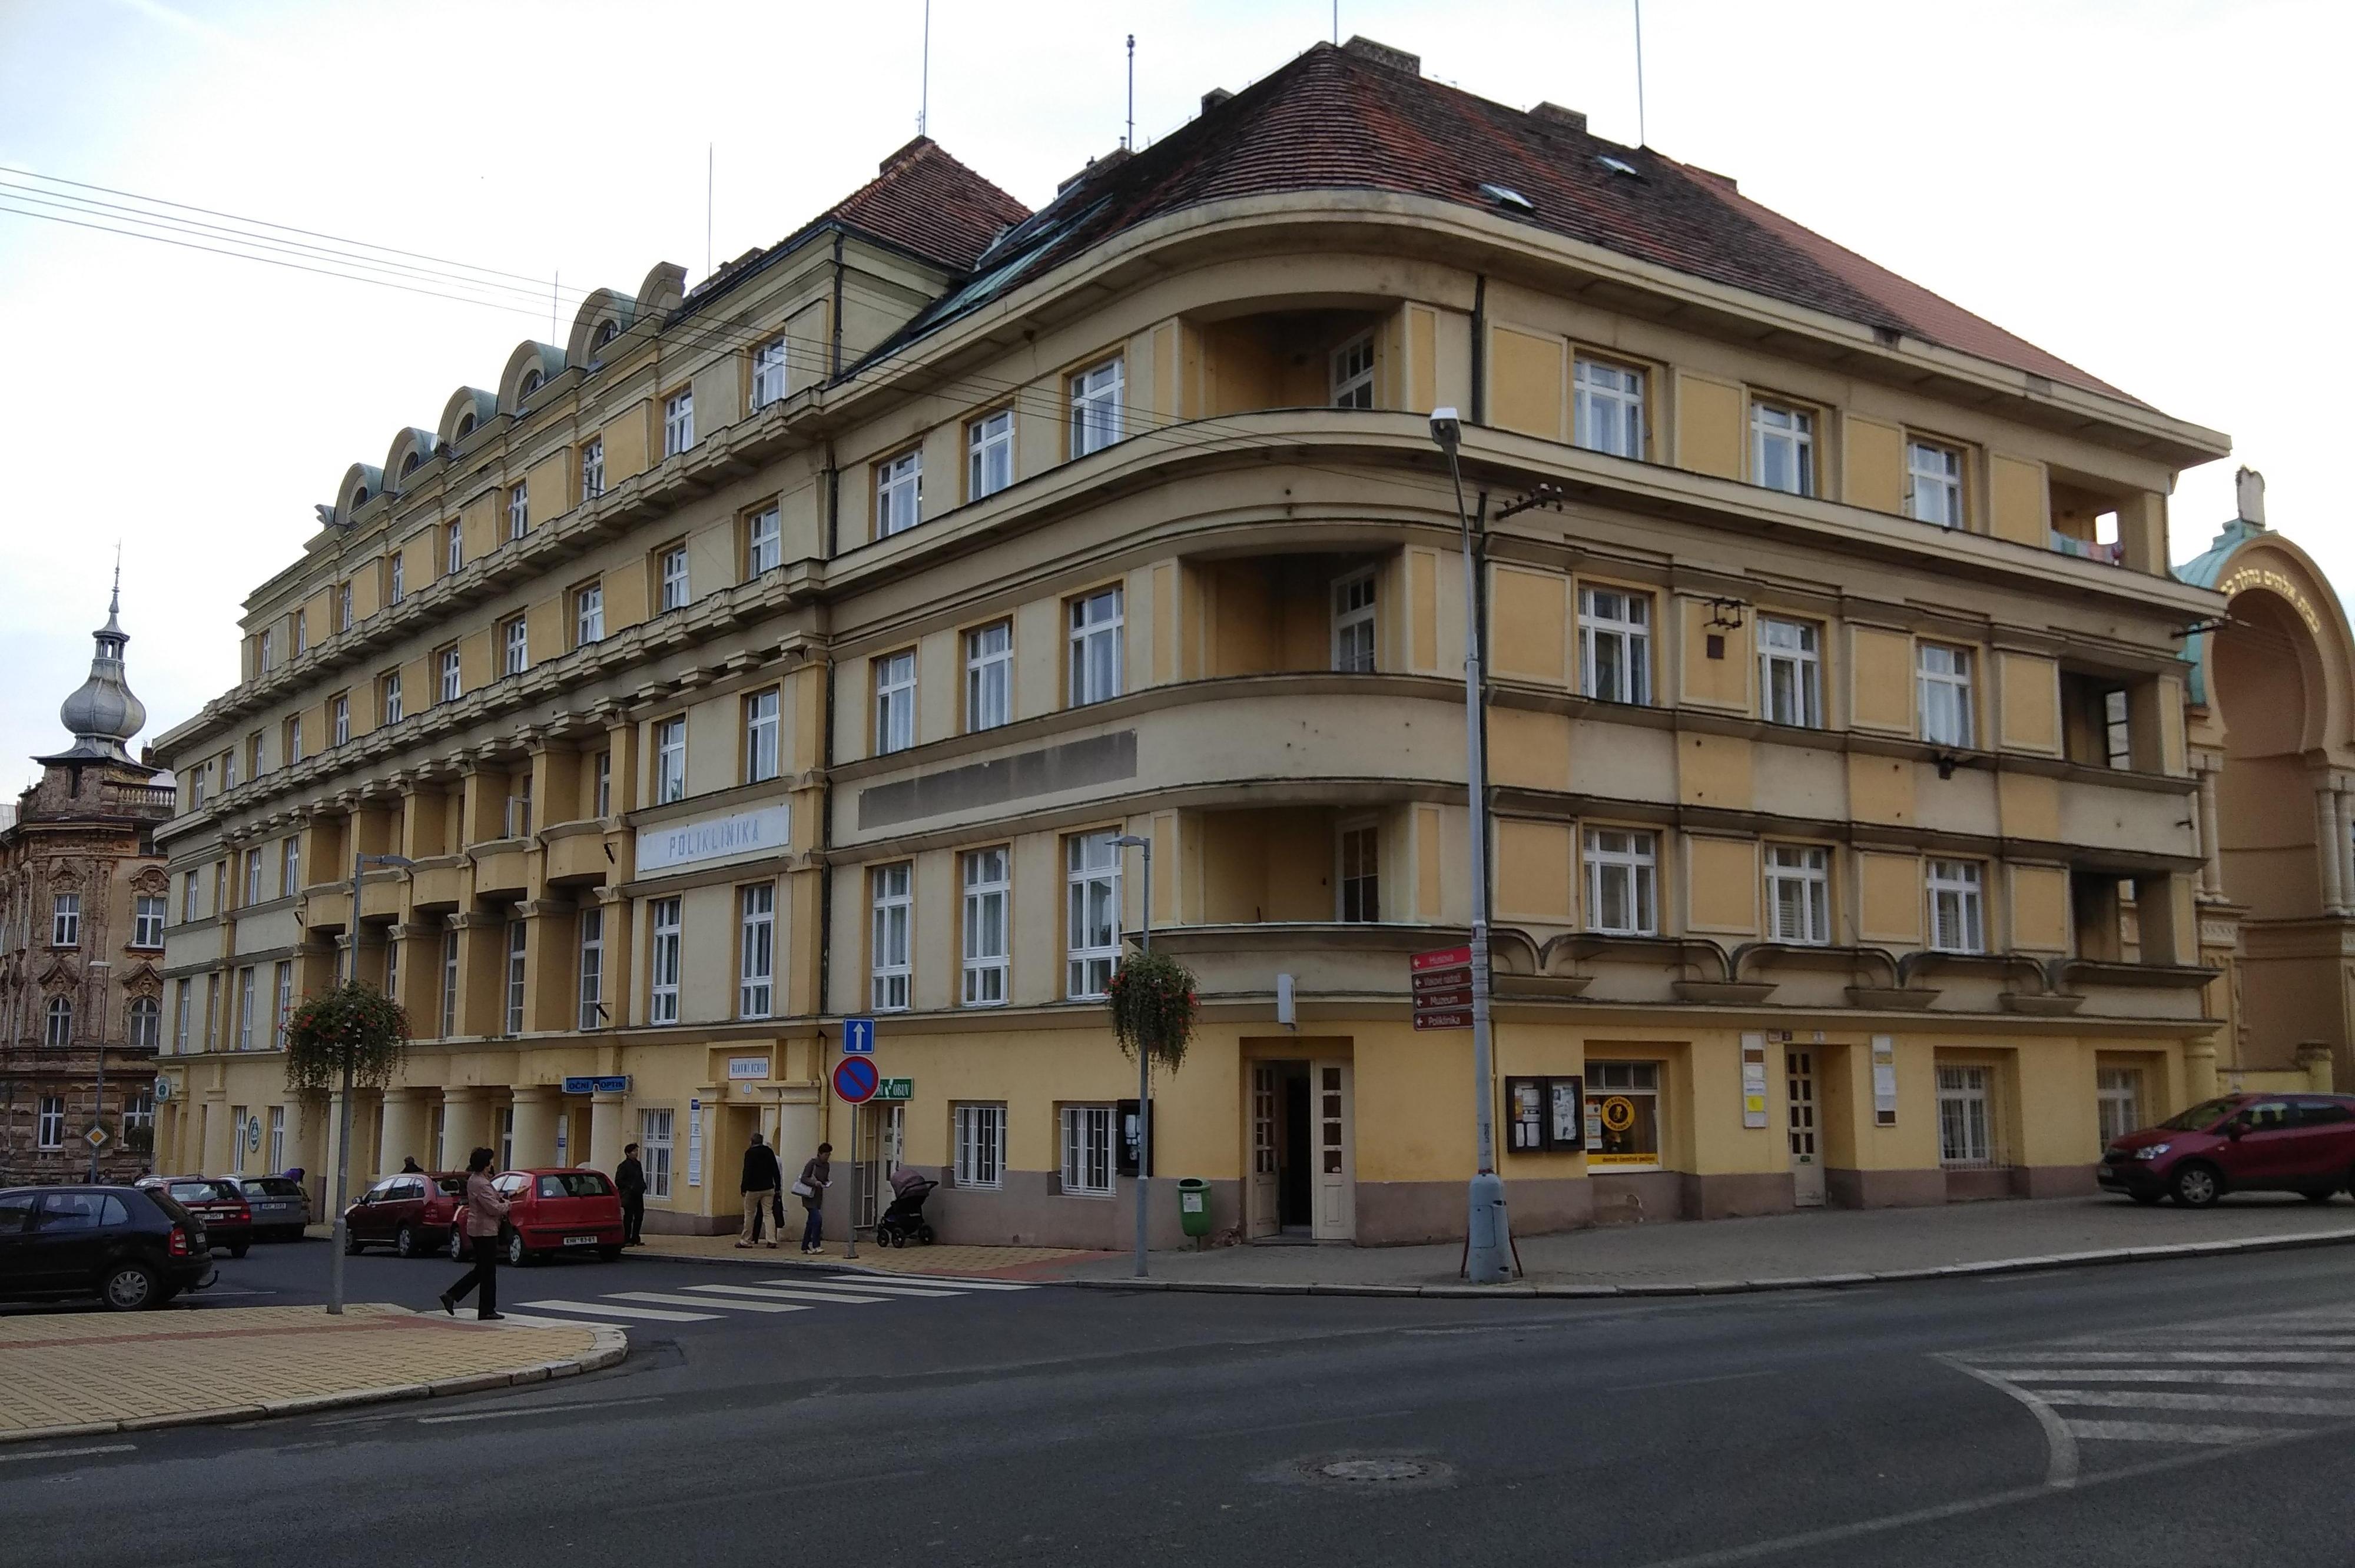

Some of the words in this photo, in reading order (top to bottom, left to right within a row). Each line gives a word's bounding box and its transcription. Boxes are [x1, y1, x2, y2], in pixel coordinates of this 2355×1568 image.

[669, 819, 758, 858] POLIKLINIKA
[1430, 996, 1458, 1005] Muzeum
[1428, 1015, 1461, 1026] Poliklinika
[893, 1084, 909, 1096] OBUV
